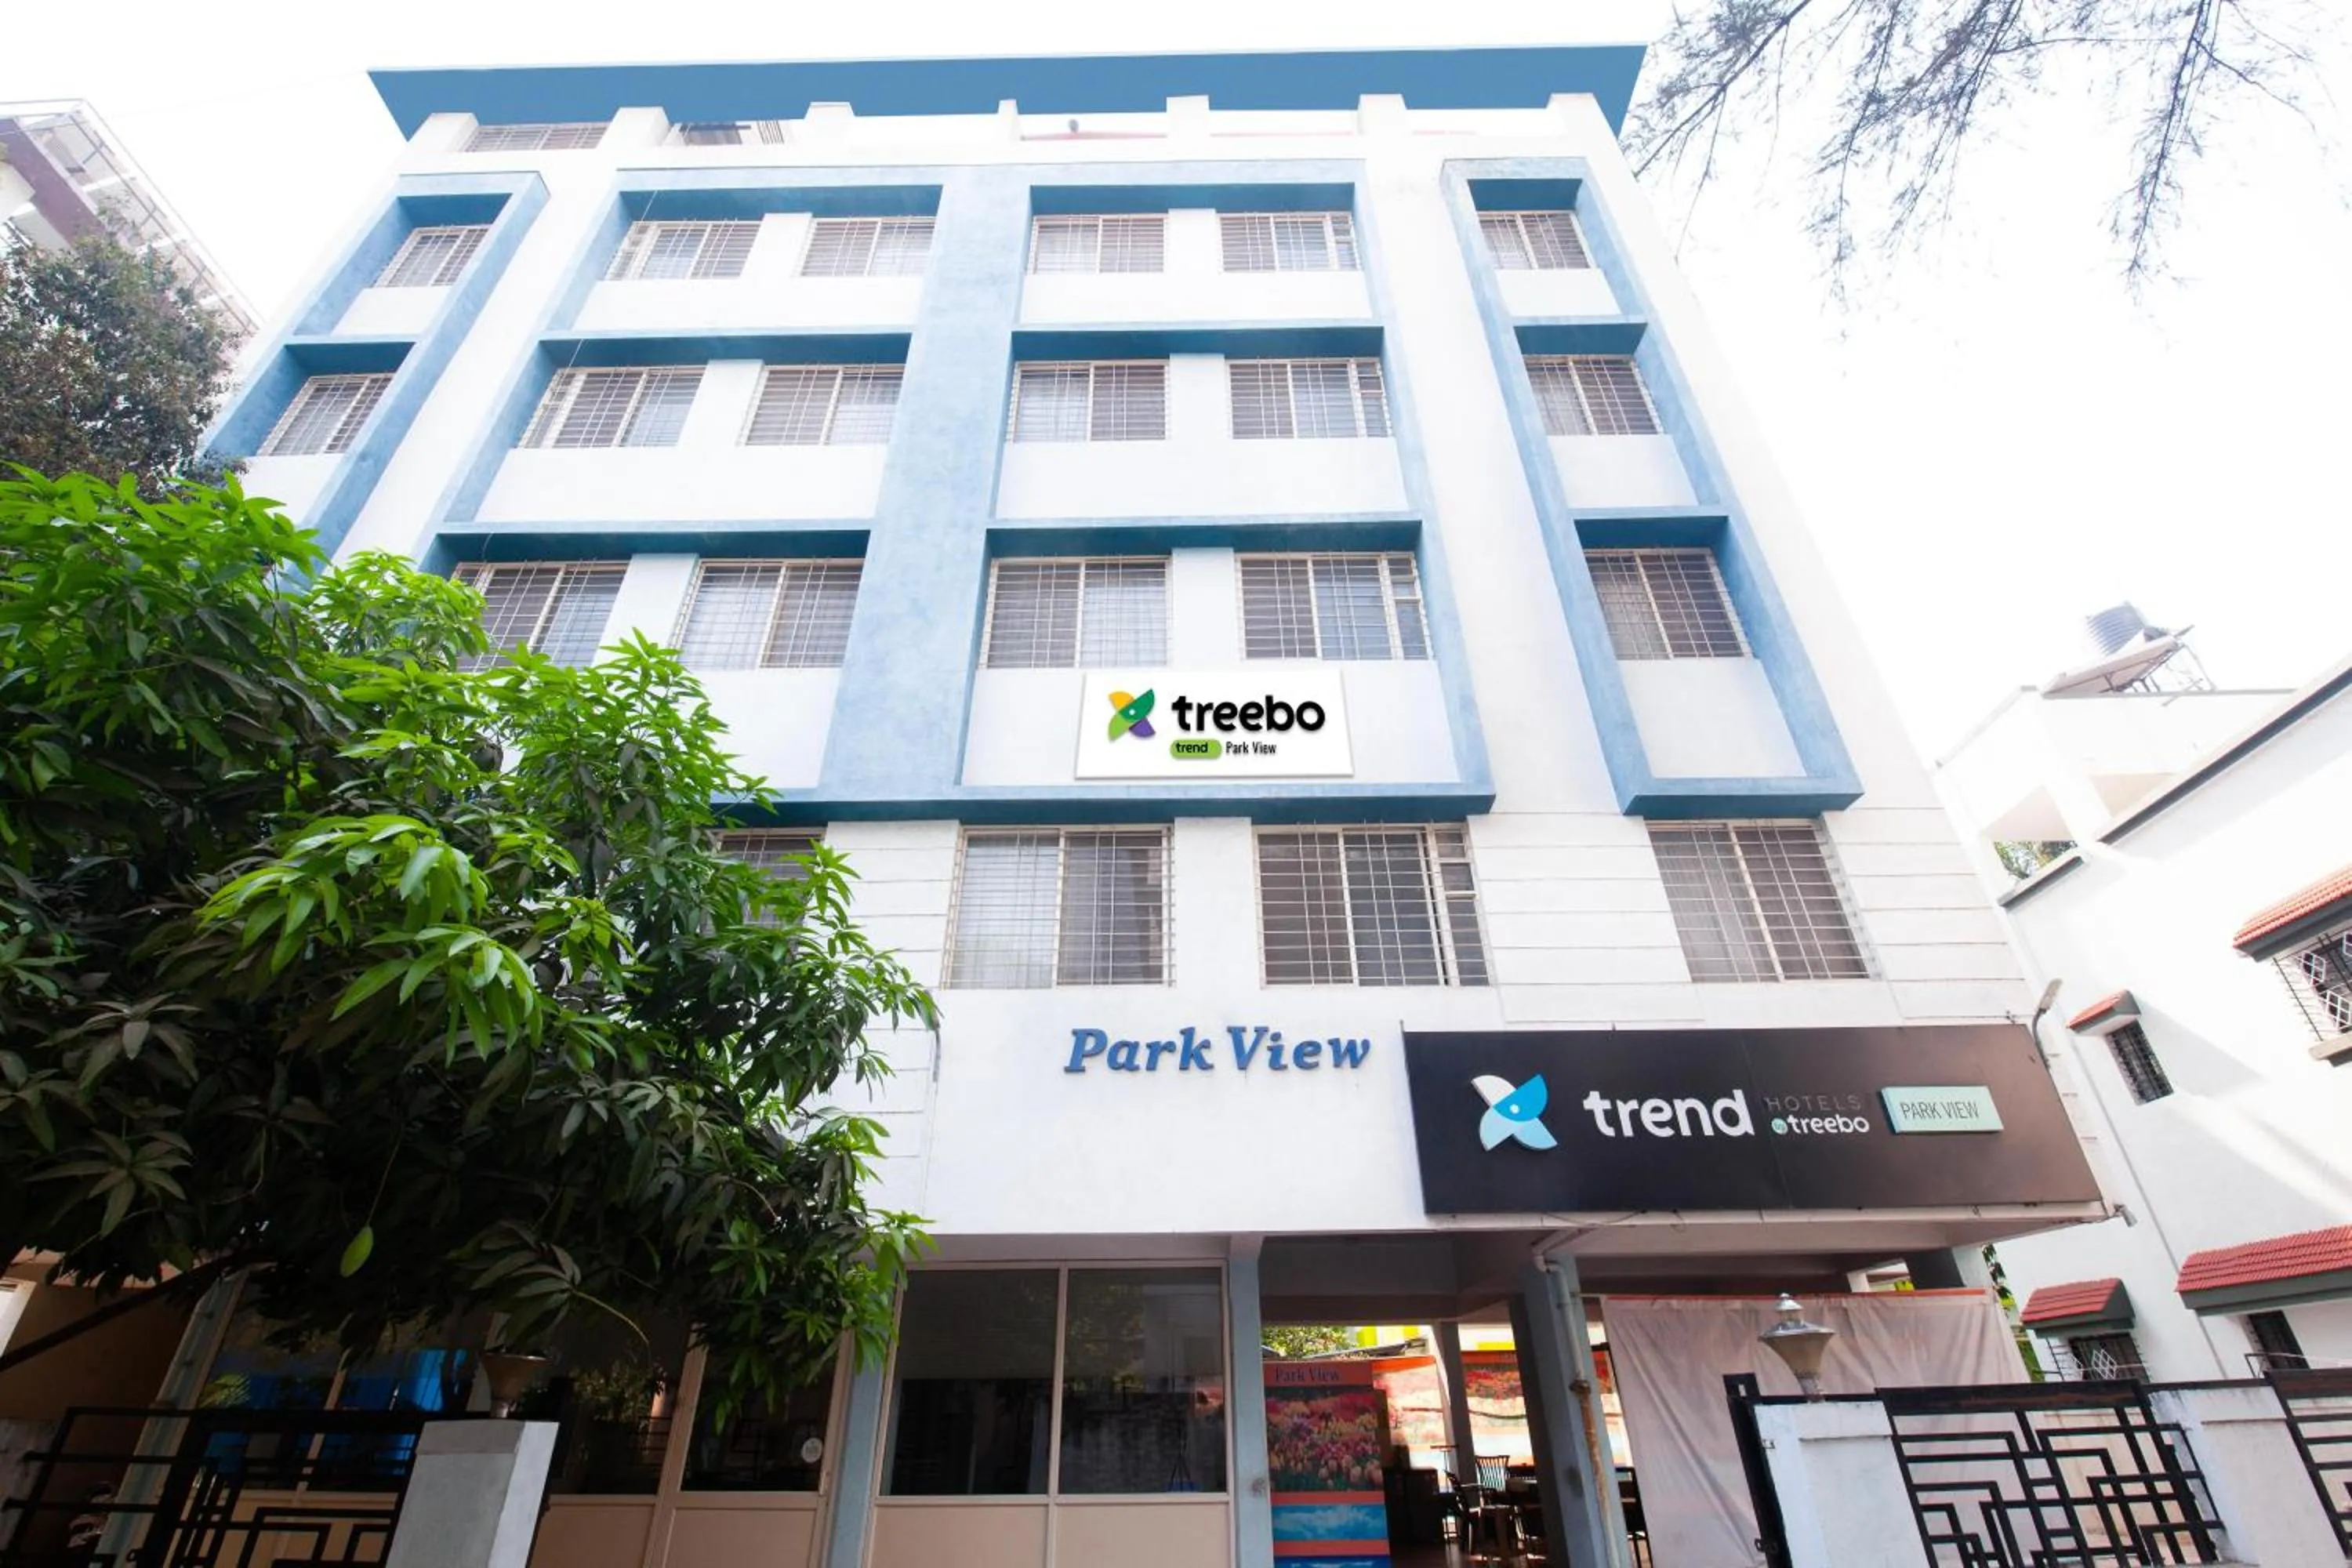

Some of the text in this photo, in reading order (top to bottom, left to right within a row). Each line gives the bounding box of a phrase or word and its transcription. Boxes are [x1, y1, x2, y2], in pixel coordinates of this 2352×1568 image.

[1171, 695, 1326, 731] treebo
[1175, 741, 1276, 754] trend Park View
[1064, 1025, 1371, 1073] Park View
[1583, 1089, 1755, 1137] trend
[1765, 1096, 1862, 1112] HOTELS
[1900, 1102, 1980, 1119] PARK VIEW
[1788, 1114, 1870, 1134] treebo
